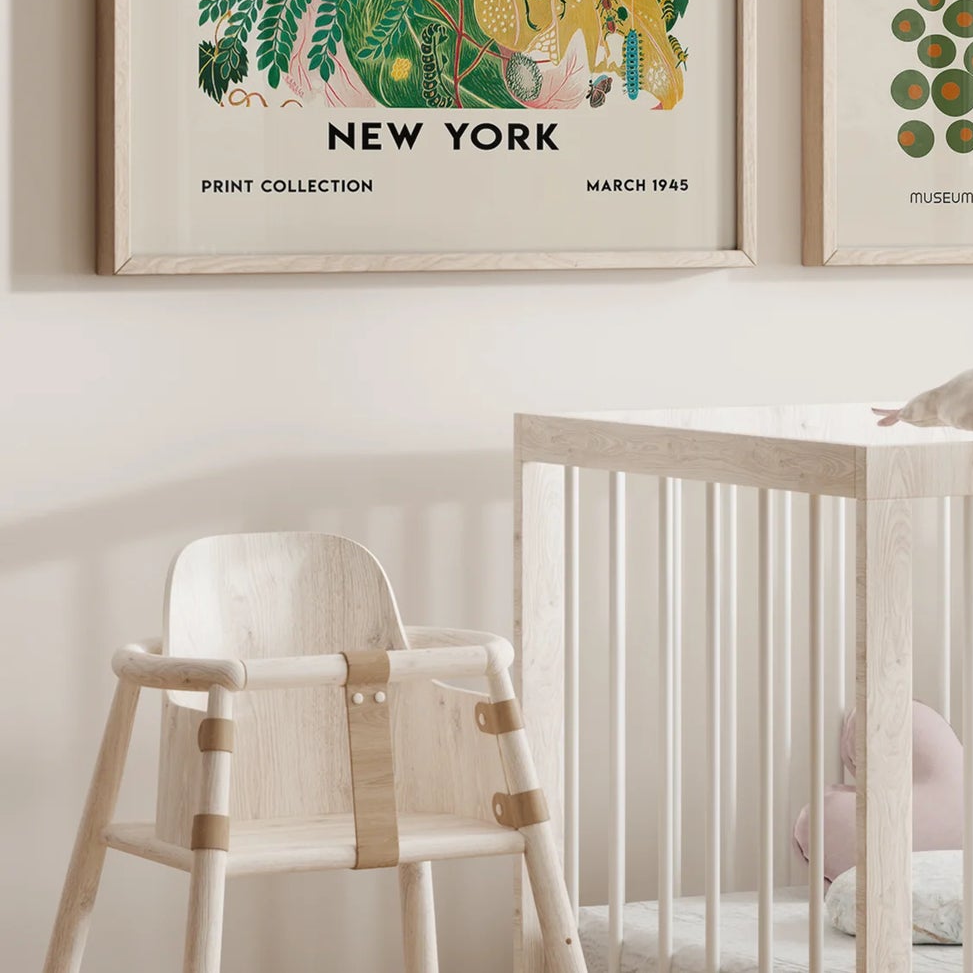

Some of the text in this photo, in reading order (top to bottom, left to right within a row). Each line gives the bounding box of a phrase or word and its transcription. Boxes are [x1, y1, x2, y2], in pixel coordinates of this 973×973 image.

[329, 122, 559, 150] NEW YORK
[201, 179, 373, 193] PRINT COLLECTION
[587, 178, 689, 191] MARCH 1945
[910, 191, 973, 203] MUSEUM
